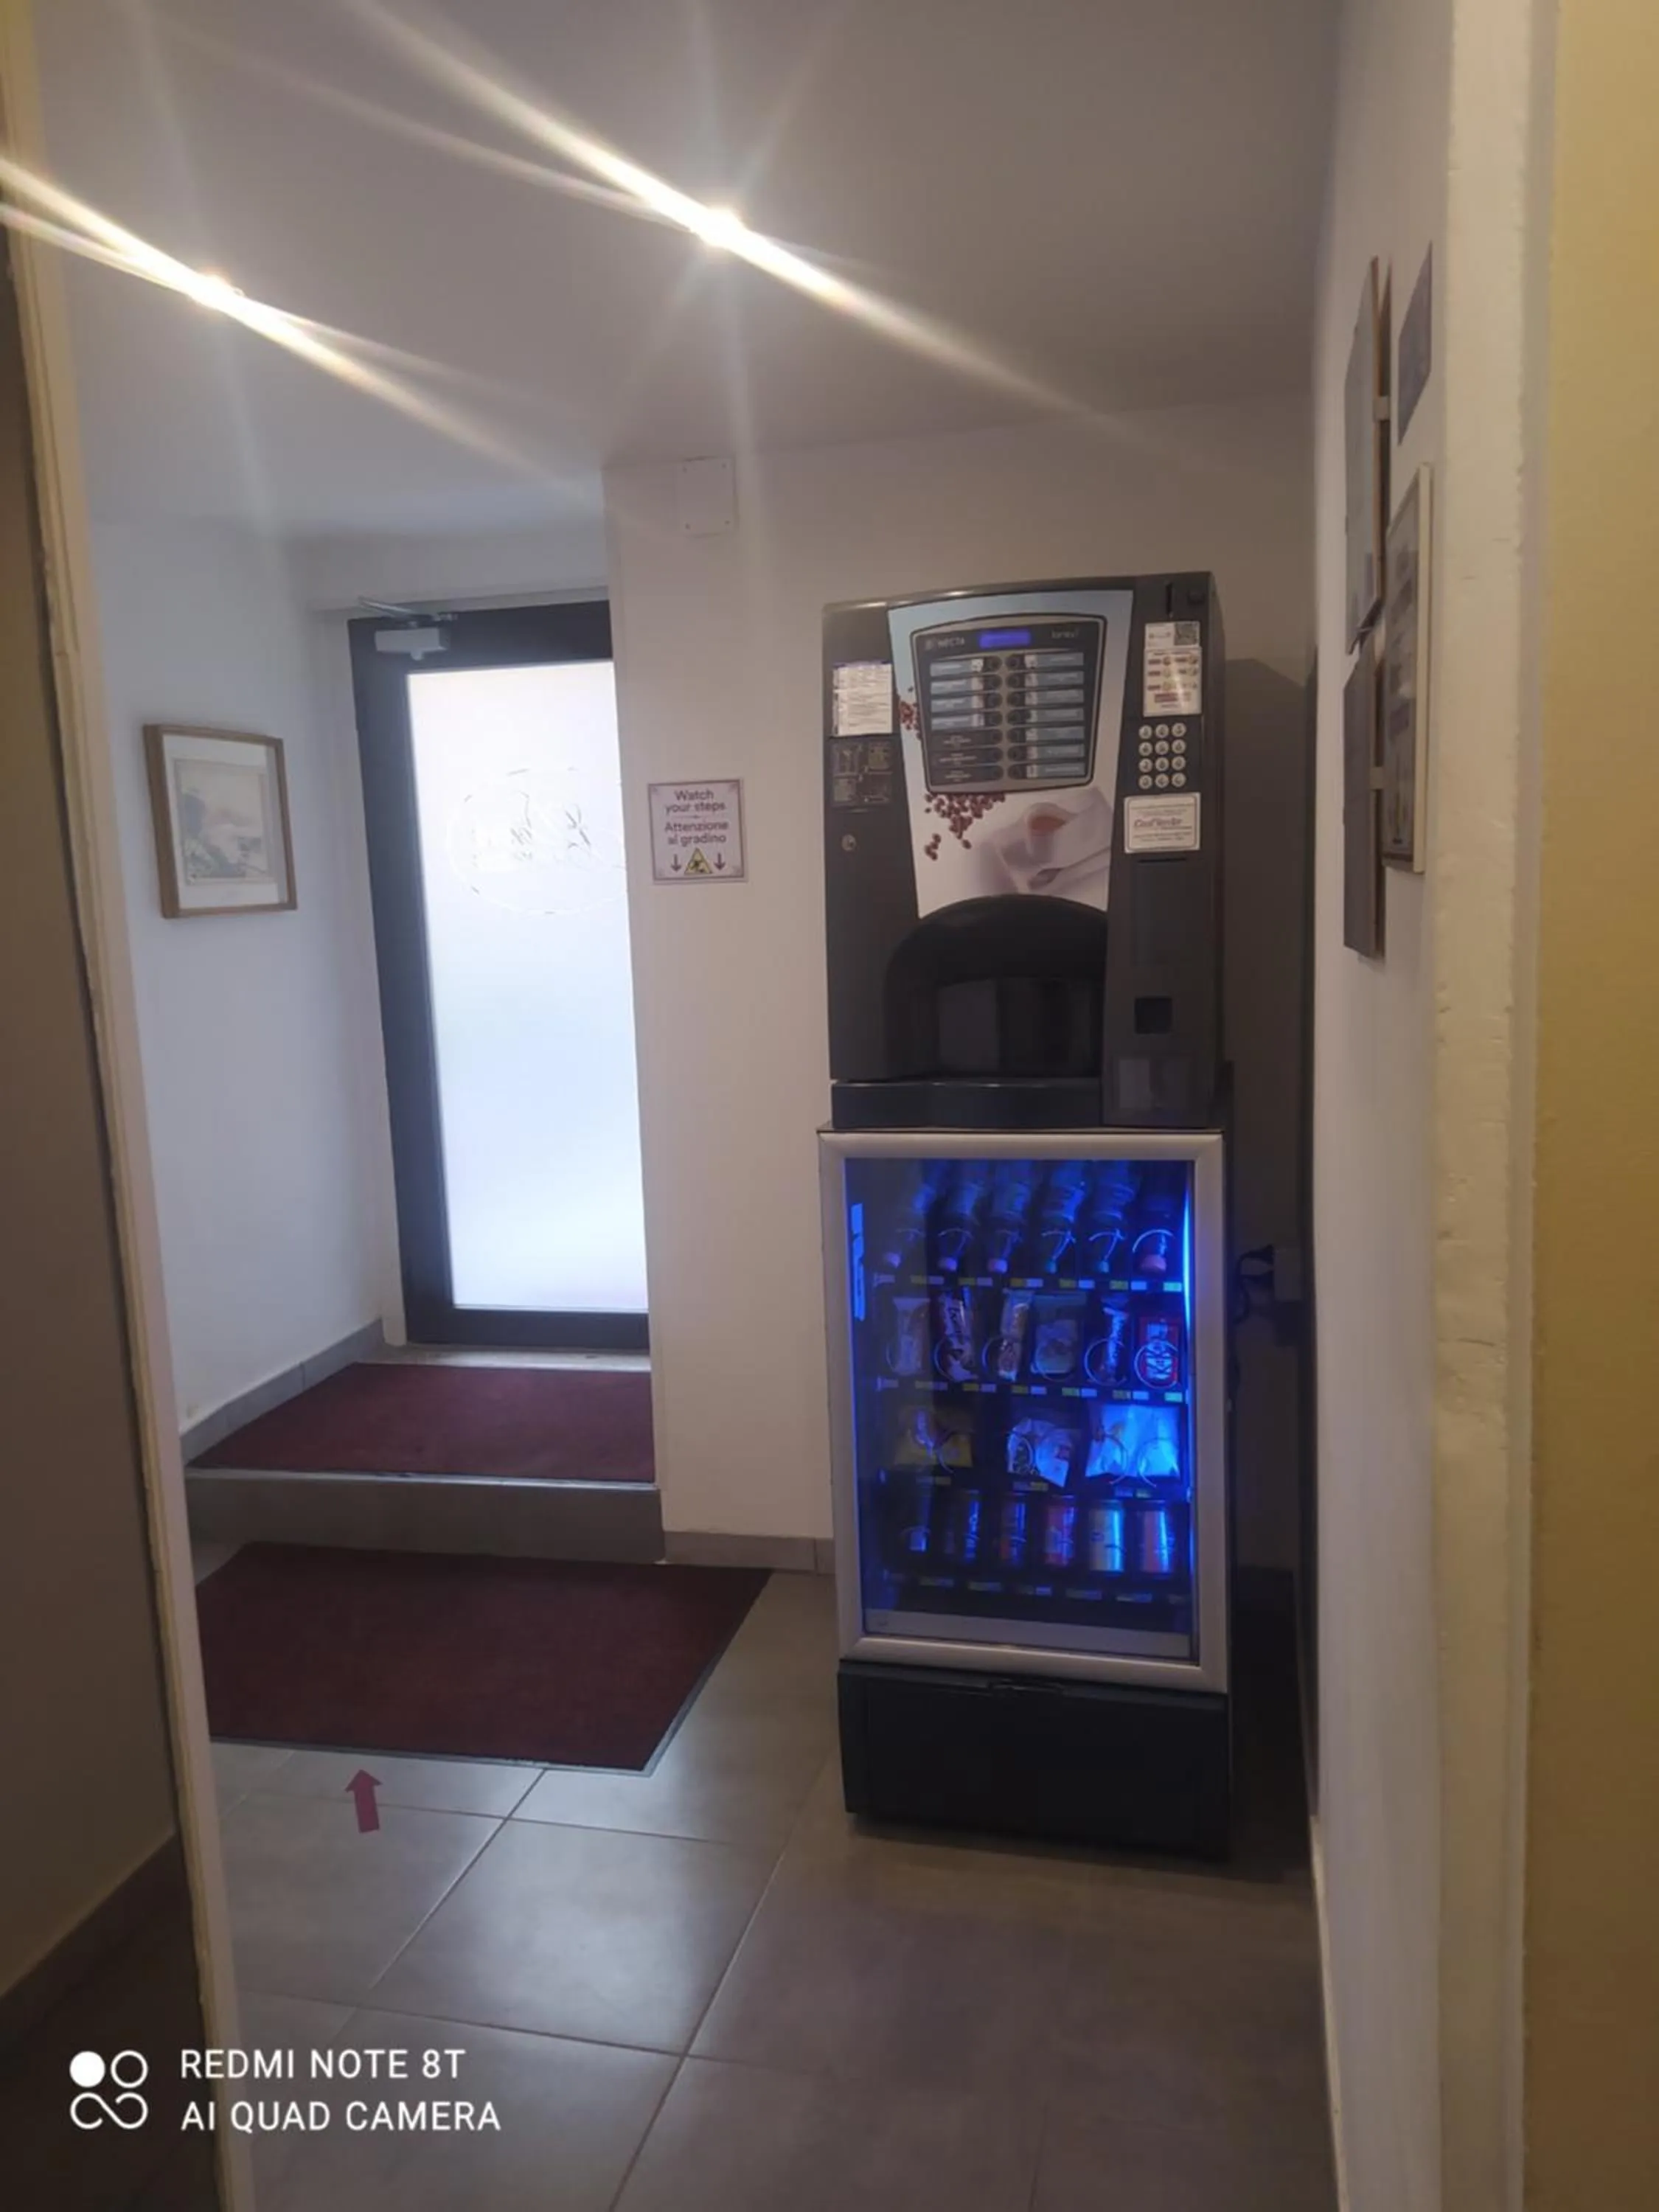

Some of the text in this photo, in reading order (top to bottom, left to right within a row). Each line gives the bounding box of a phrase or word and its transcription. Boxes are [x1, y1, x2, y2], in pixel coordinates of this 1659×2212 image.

[674, 789, 714, 801] Watch
[665, 801, 726, 815] your steps
[665, 821, 729, 832] Attenzione
[680, 833, 726, 847] gradino
